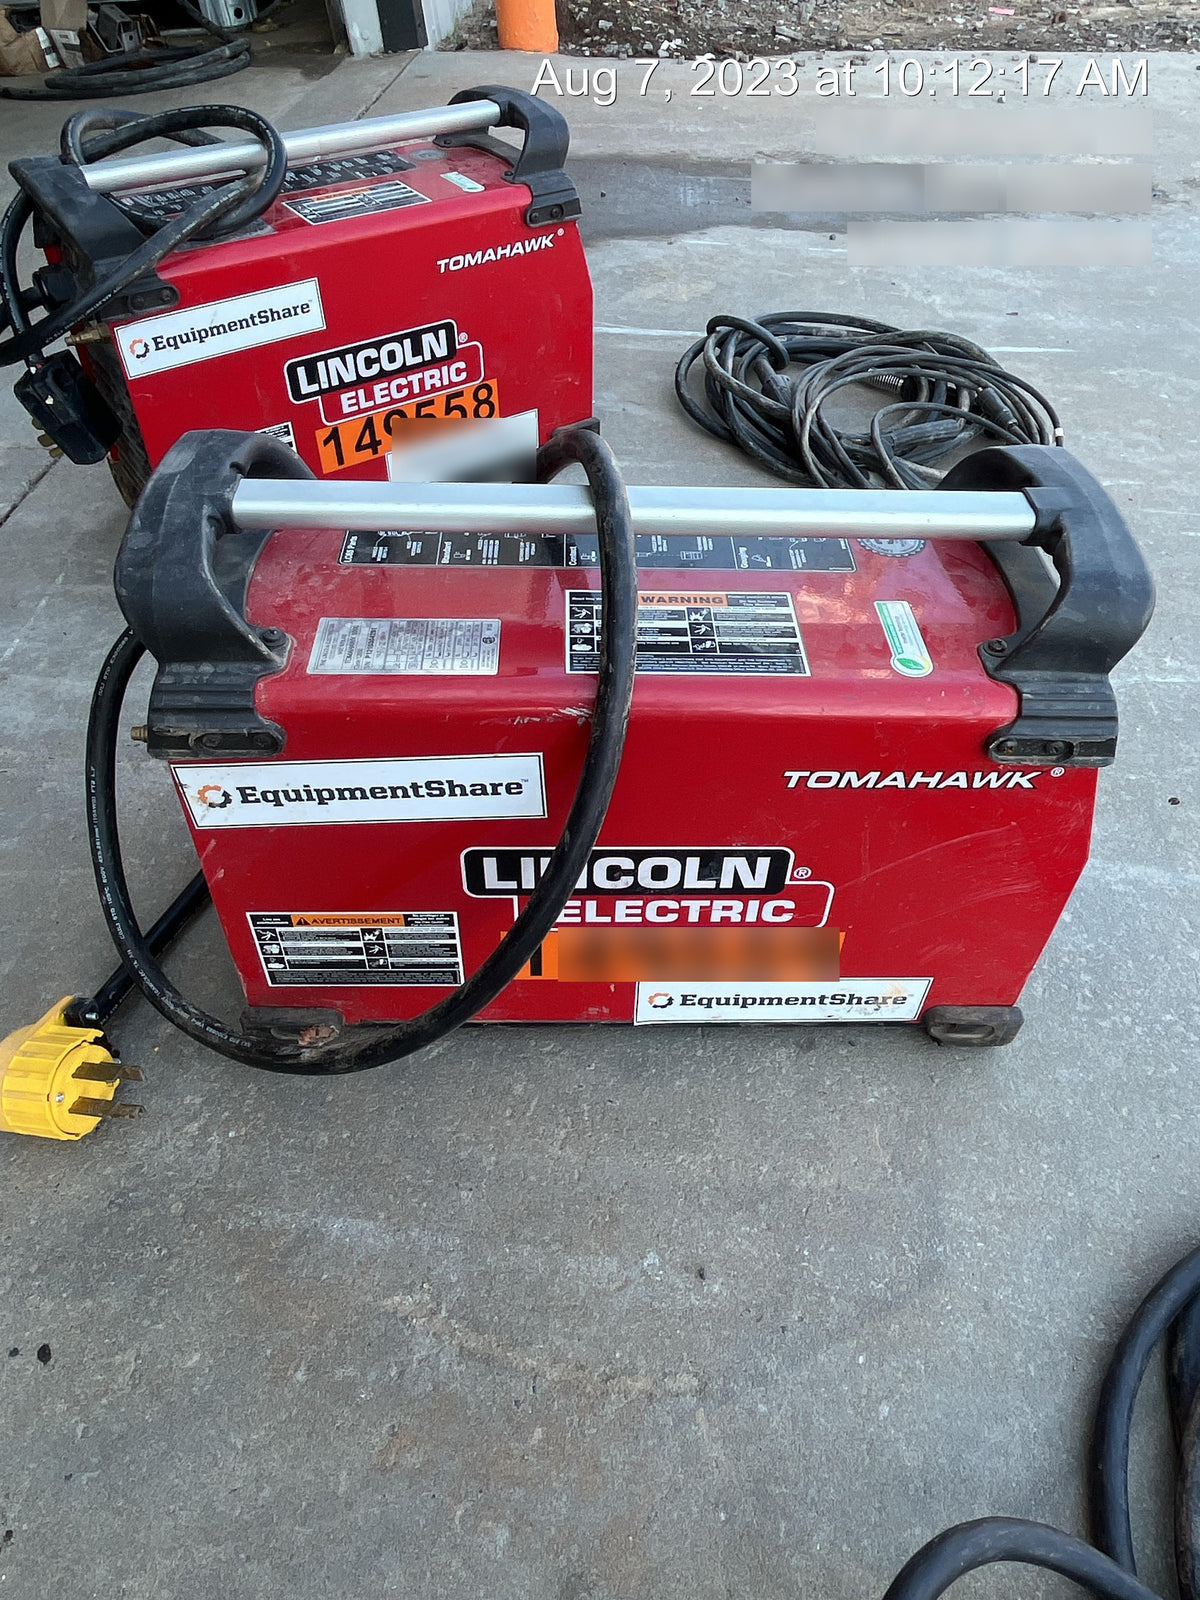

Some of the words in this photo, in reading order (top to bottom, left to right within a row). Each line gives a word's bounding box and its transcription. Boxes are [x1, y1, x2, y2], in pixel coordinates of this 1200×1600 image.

[436, 233, 556, 274] TOMAHAWK
[151, 301, 311, 351] EquipmentShare
[296, 328, 449, 395] LINCOLN
[340, 361, 467, 414] ELECTRIC
[641, 595, 724, 605] WARNING
[235, 778, 525, 808] EquipmentShare
[783, 770, 1042, 789] TOMAHAWK
[482, 856, 772, 889] LICOLN
[311, 916, 402, 926] AVERTISSEMENT
[556, 900, 796, 924] ELECTRIC
[679, 992, 908, 1009] EquipmentShare
